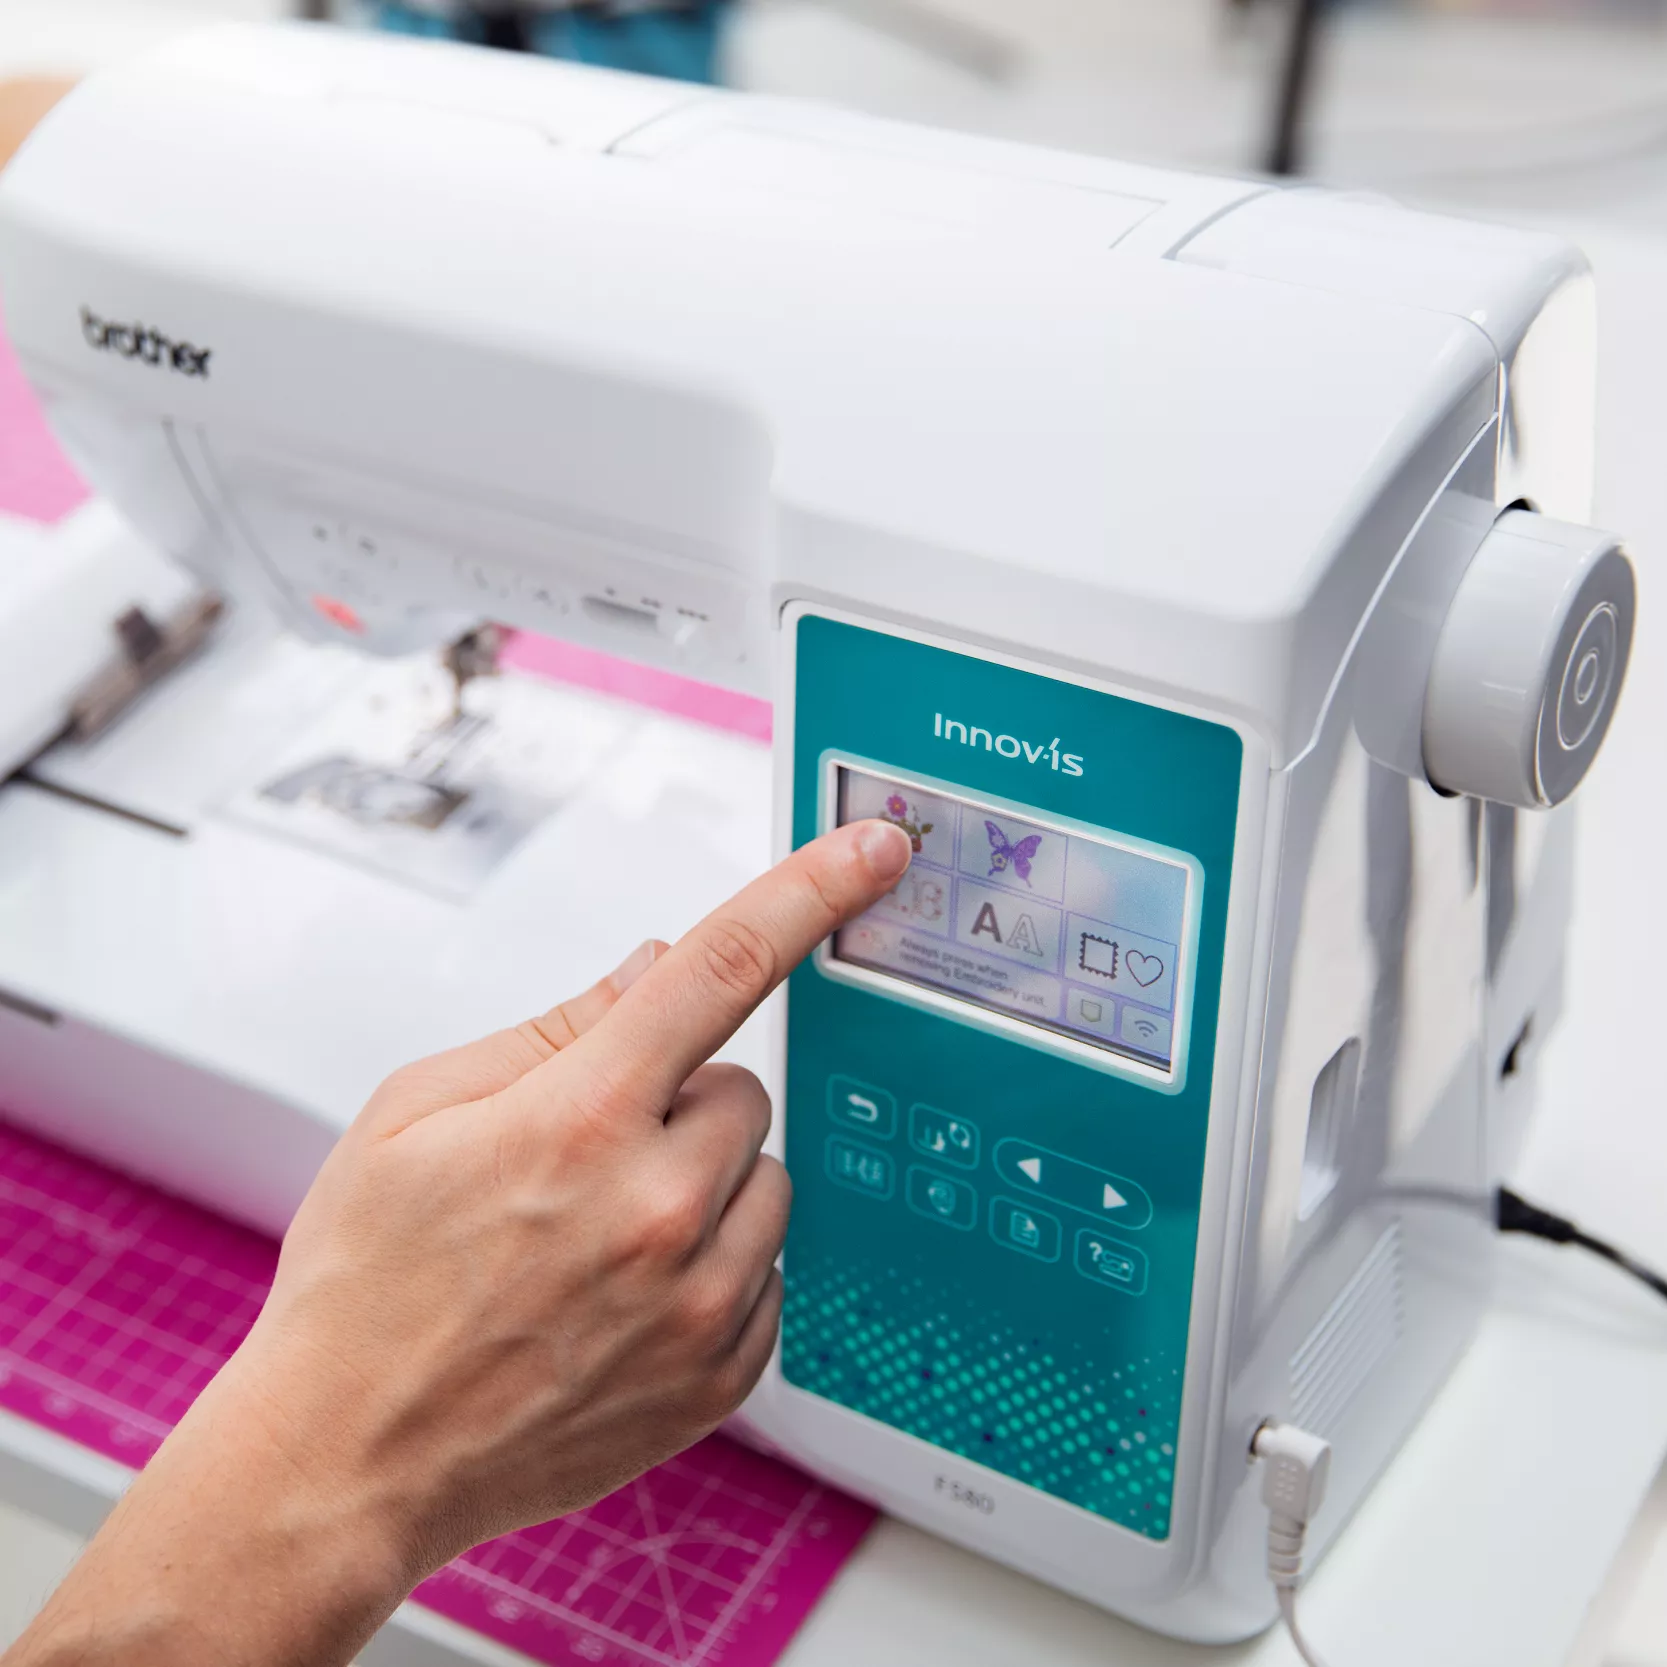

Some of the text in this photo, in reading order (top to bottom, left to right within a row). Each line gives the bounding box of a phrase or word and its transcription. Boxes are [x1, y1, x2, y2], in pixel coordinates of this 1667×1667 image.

[81, 302, 210, 380] brother
[900, 936, 1008, 980] Always press when
[953, 966, 1019, 1000] Embroidery
